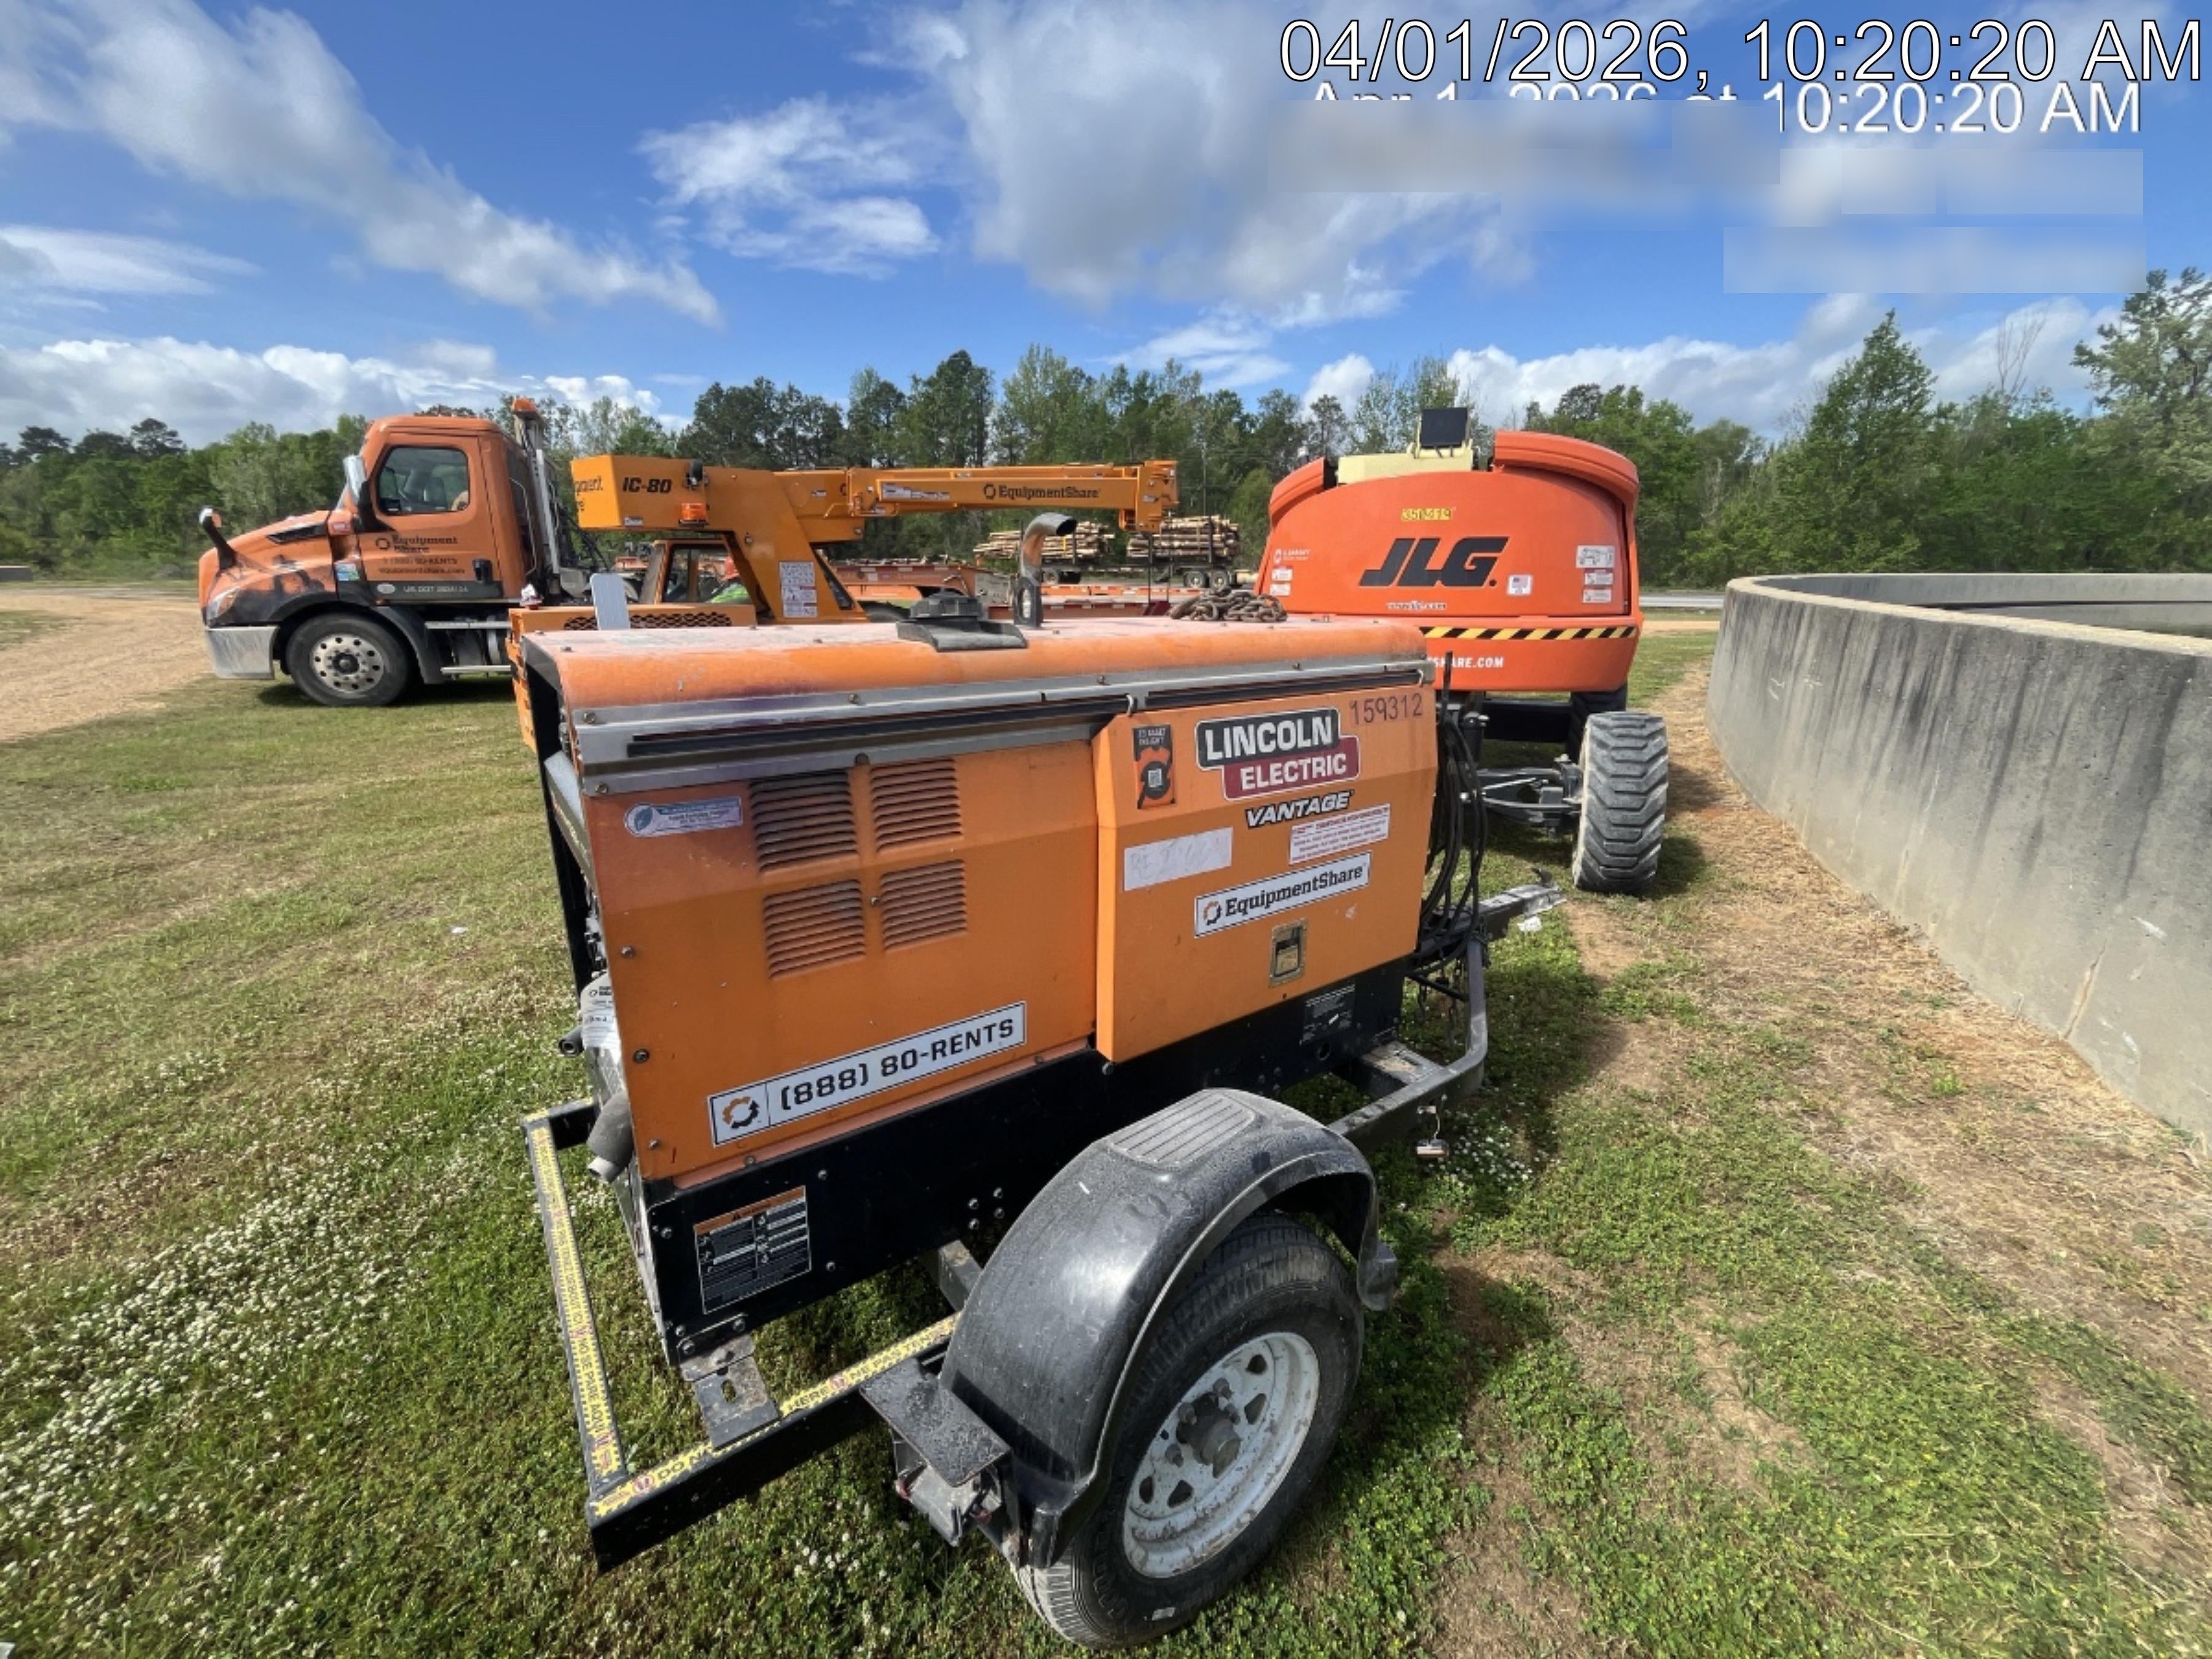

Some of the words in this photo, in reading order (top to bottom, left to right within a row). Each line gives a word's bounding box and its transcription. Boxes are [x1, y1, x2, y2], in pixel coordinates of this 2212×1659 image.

[622, 476, 673, 493] IC-80
[998, 484, 1099, 501] EquipmentShare
[1349, 692, 1423, 726] 159312
[1205, 716, 1333, 761] LINCOLN
[1240, 753, 1347, 791] ELECTRIC
[1246, 791, 1349, 828] VANTAGE
[1225, 865, 1363, 916] EquipmentShare
[781, 1063, 869, 1110] (888)
[880, 1018, 1014, 1077] 80-RENTS
[658, 1461, 684, 1479] DO
